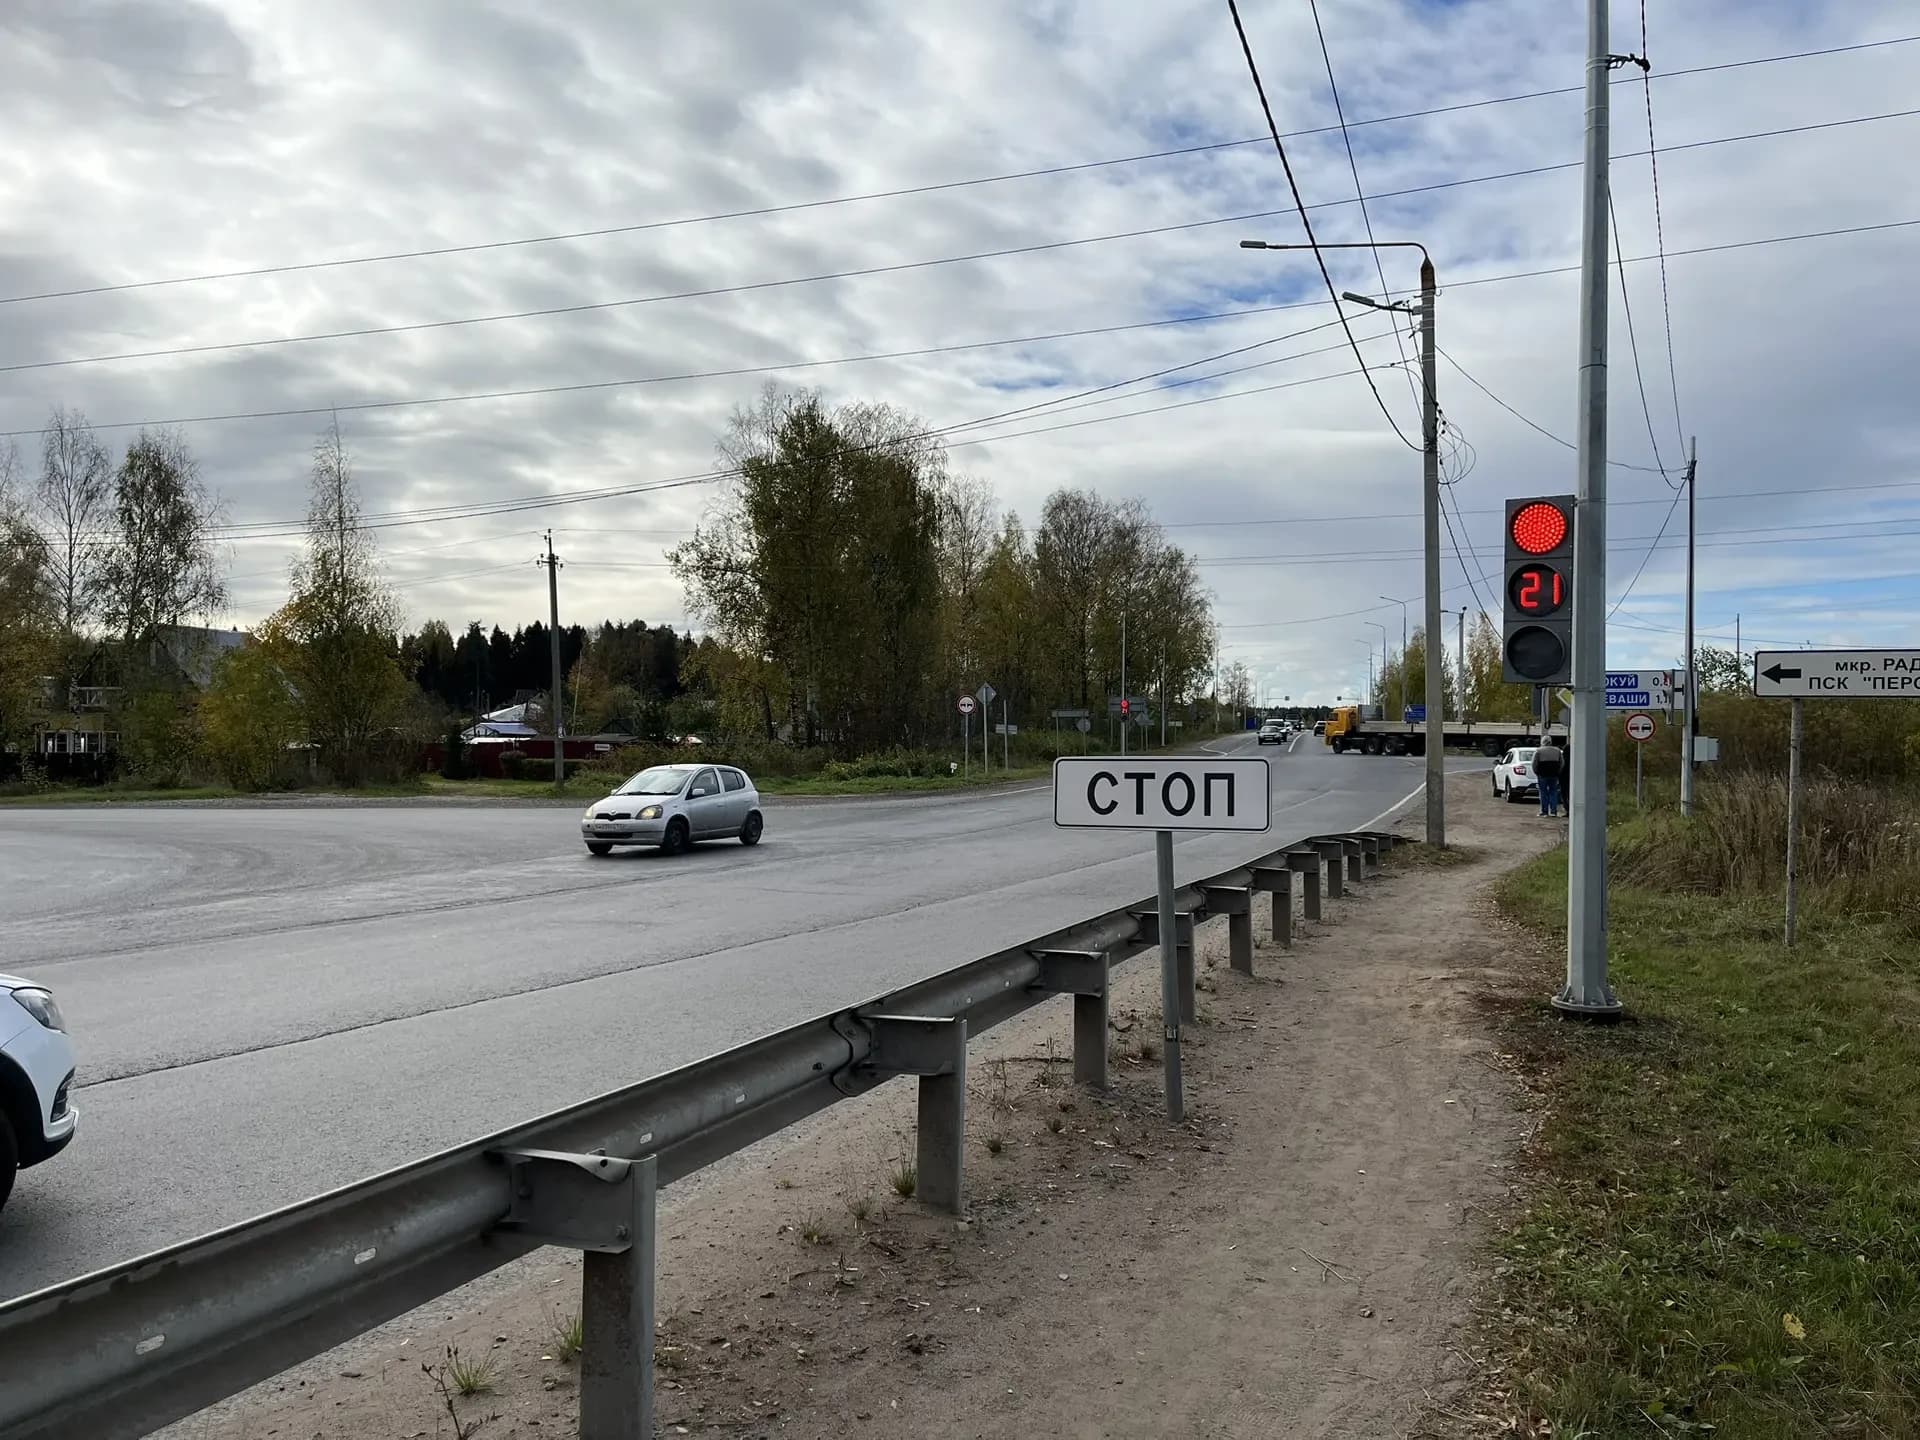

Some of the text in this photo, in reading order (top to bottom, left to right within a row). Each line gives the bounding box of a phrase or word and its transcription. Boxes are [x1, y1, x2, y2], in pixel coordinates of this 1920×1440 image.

[1520, 572, 1561, 608] 21
[1835, 661, 1876, 674] мкр.
[1809, 676, 1849, 690] ПСК
[1087, 771, 1235, 817] СТОП
